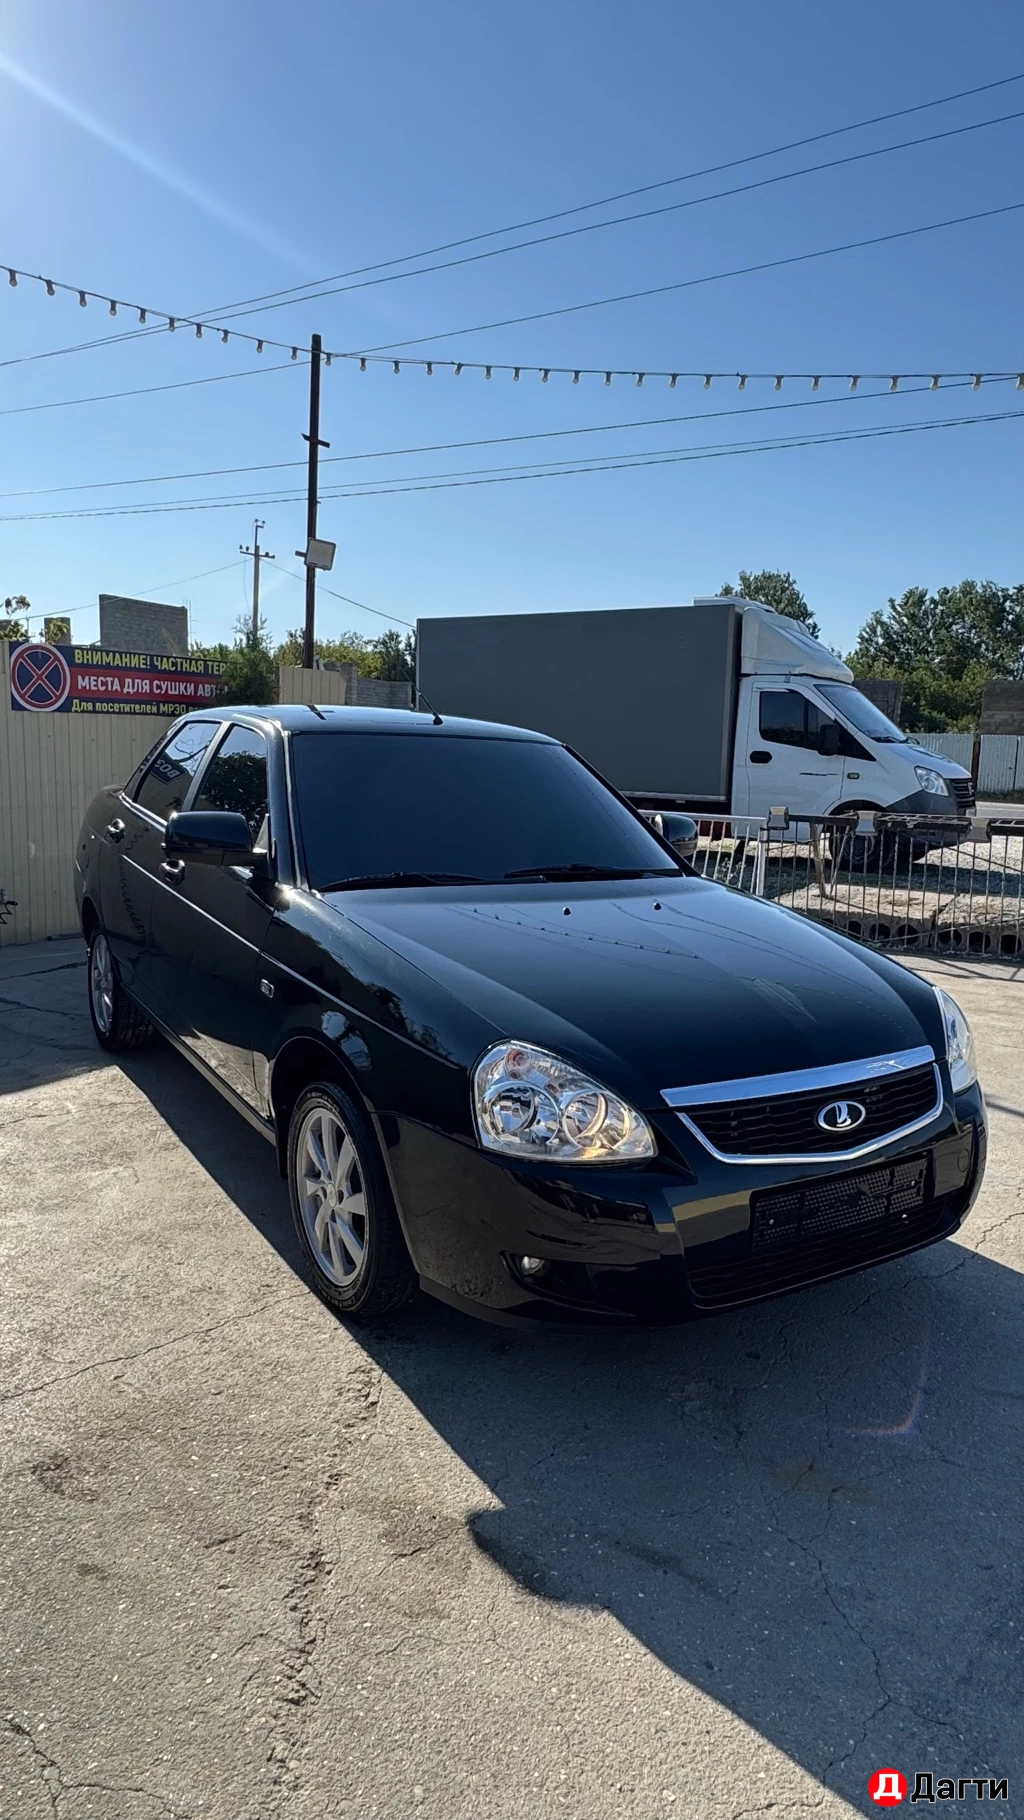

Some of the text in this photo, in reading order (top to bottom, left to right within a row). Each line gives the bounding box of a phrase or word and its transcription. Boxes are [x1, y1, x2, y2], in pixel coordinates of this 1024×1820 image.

[74, 649, 150, 669] ВНИМАНИЕ!
[153, 656, 204, 673] ЧАСТНАЯ
[77, 675, 121, 692] МЕСТА
[123, 678, 150, 694] ДЛЯ
[153, 680, 195, 696] СУШКИ
[71, 699, 93, 713] Для
[95, 702, 157, 714] посетителей
[160, 703, 186, 715] МРЭО
